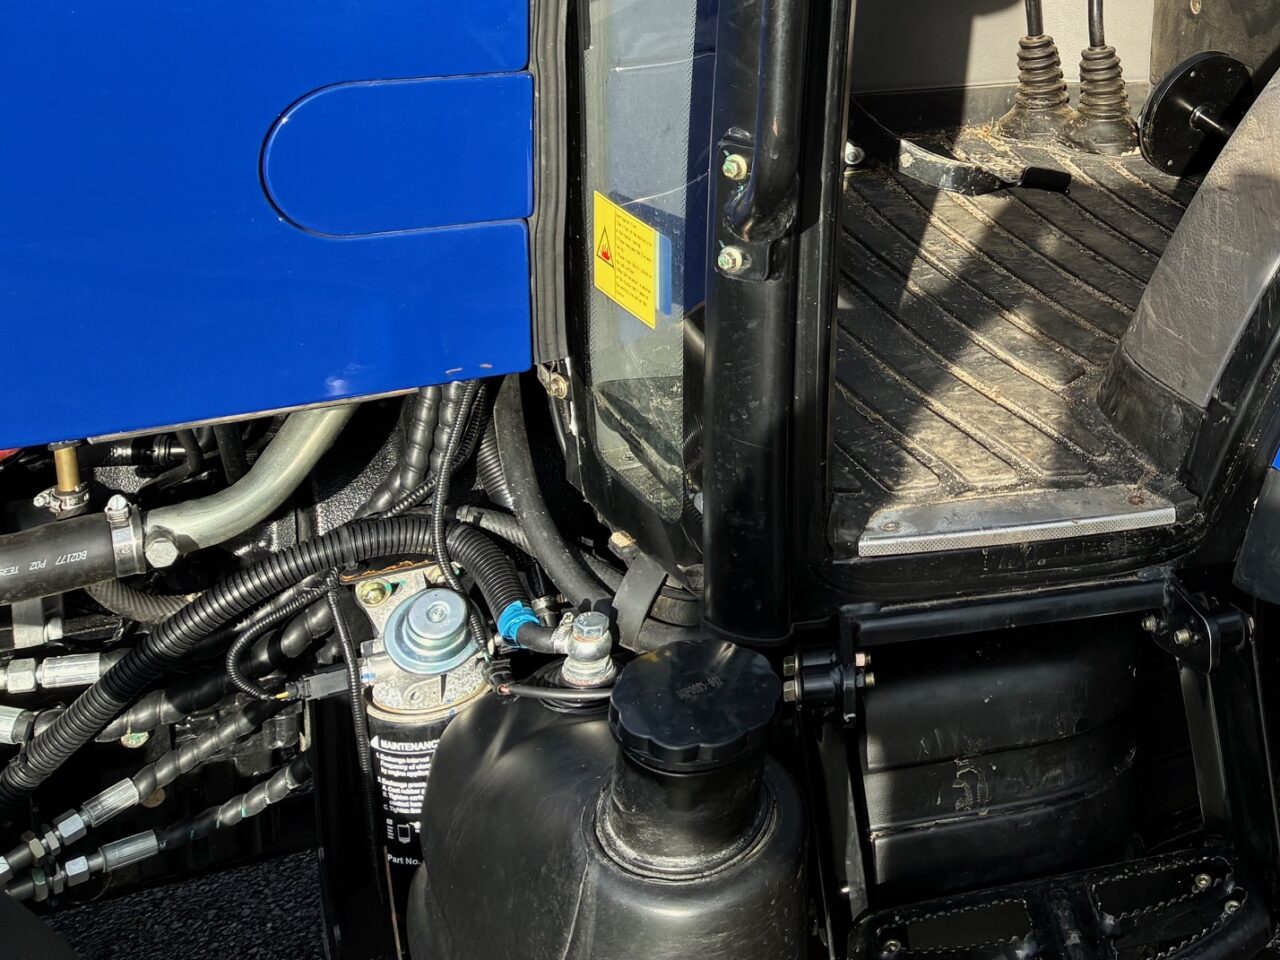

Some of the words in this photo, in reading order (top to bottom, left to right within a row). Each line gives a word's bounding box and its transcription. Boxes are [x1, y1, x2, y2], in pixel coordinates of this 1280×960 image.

[55, 550, 88, 566] B02177
[380, 739, 440, 751] MAINTENANC
[387, 853, 405, 864] Part
[405, 856, 421, 865] No.
